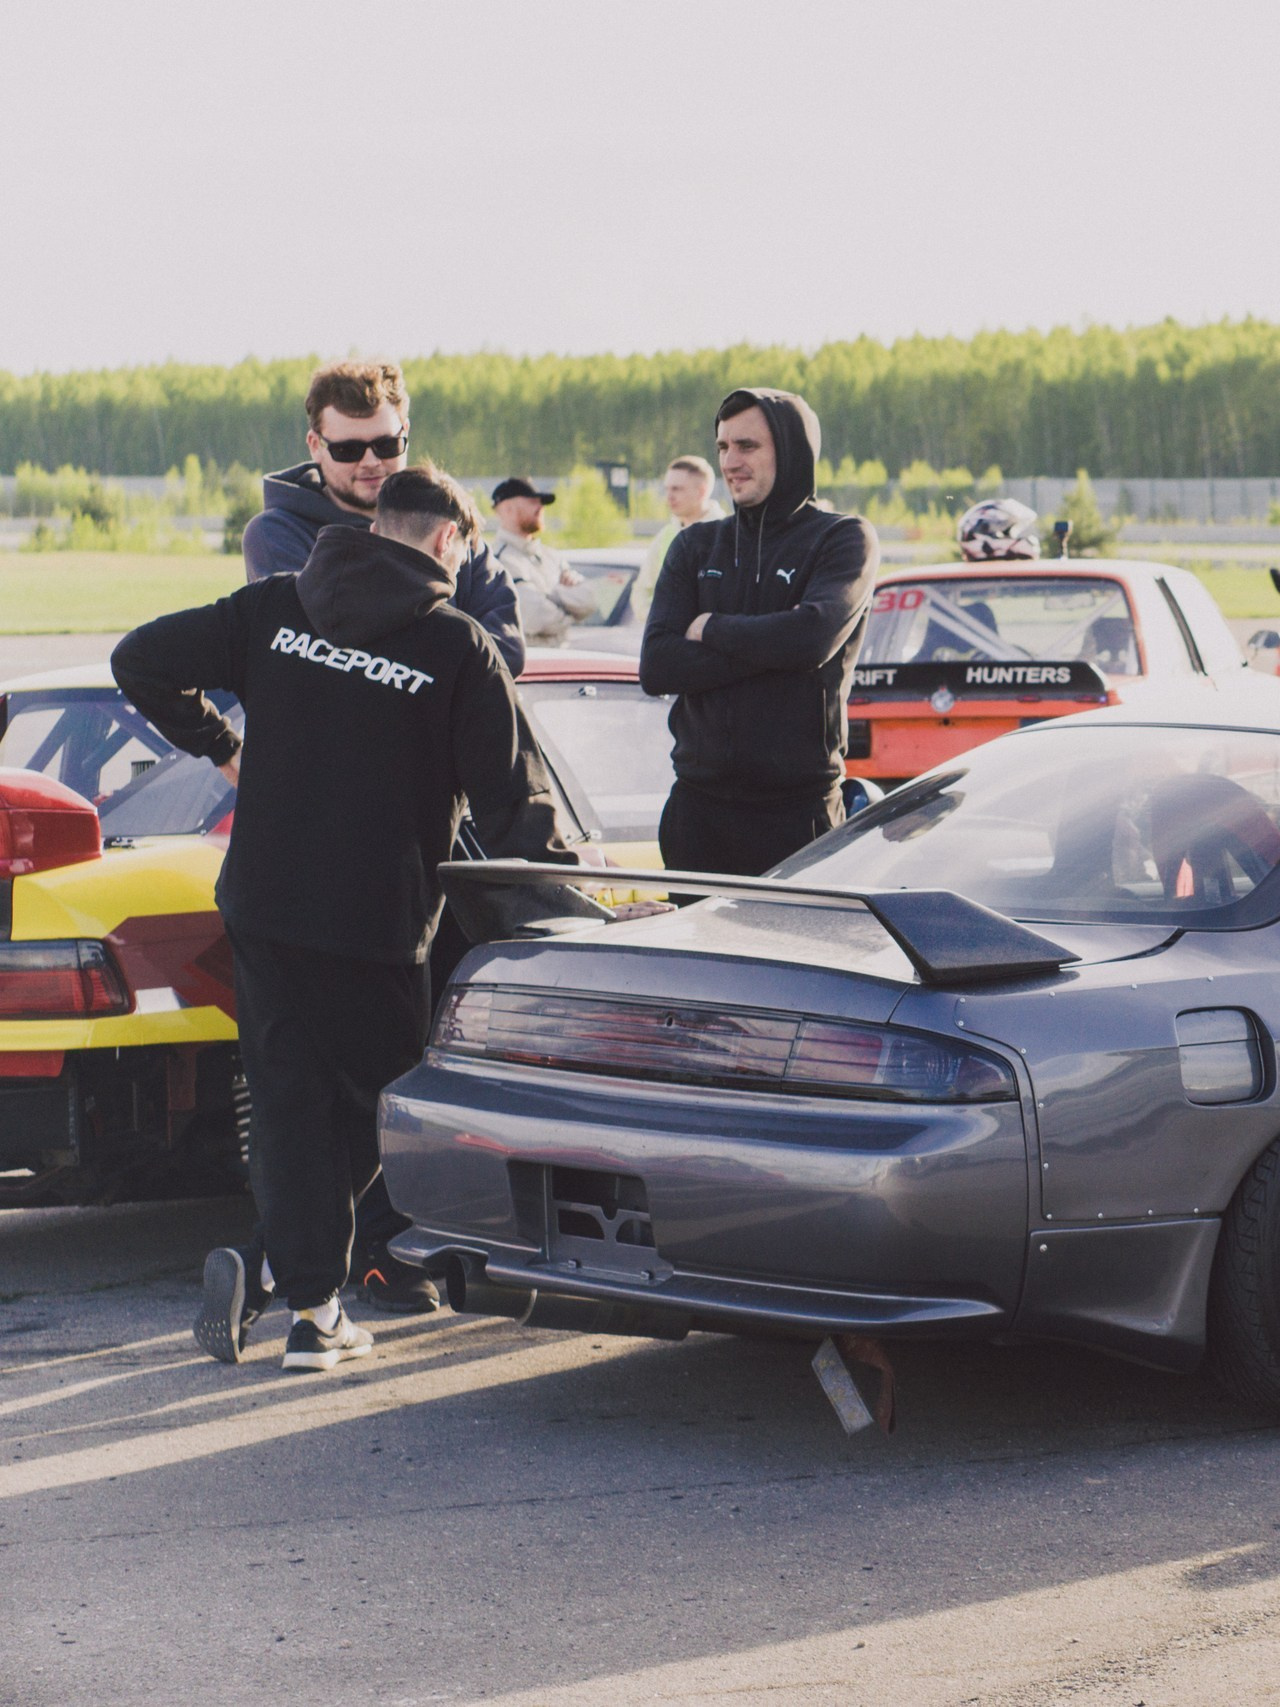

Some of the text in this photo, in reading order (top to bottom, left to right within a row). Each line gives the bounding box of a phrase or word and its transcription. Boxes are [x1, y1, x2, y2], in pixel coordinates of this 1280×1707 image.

[873, 590, 925, 614] 30
[270, 626, 434, 694] RACEPORT
[852, 667, 1071, 686] RIFT HUNTERS
